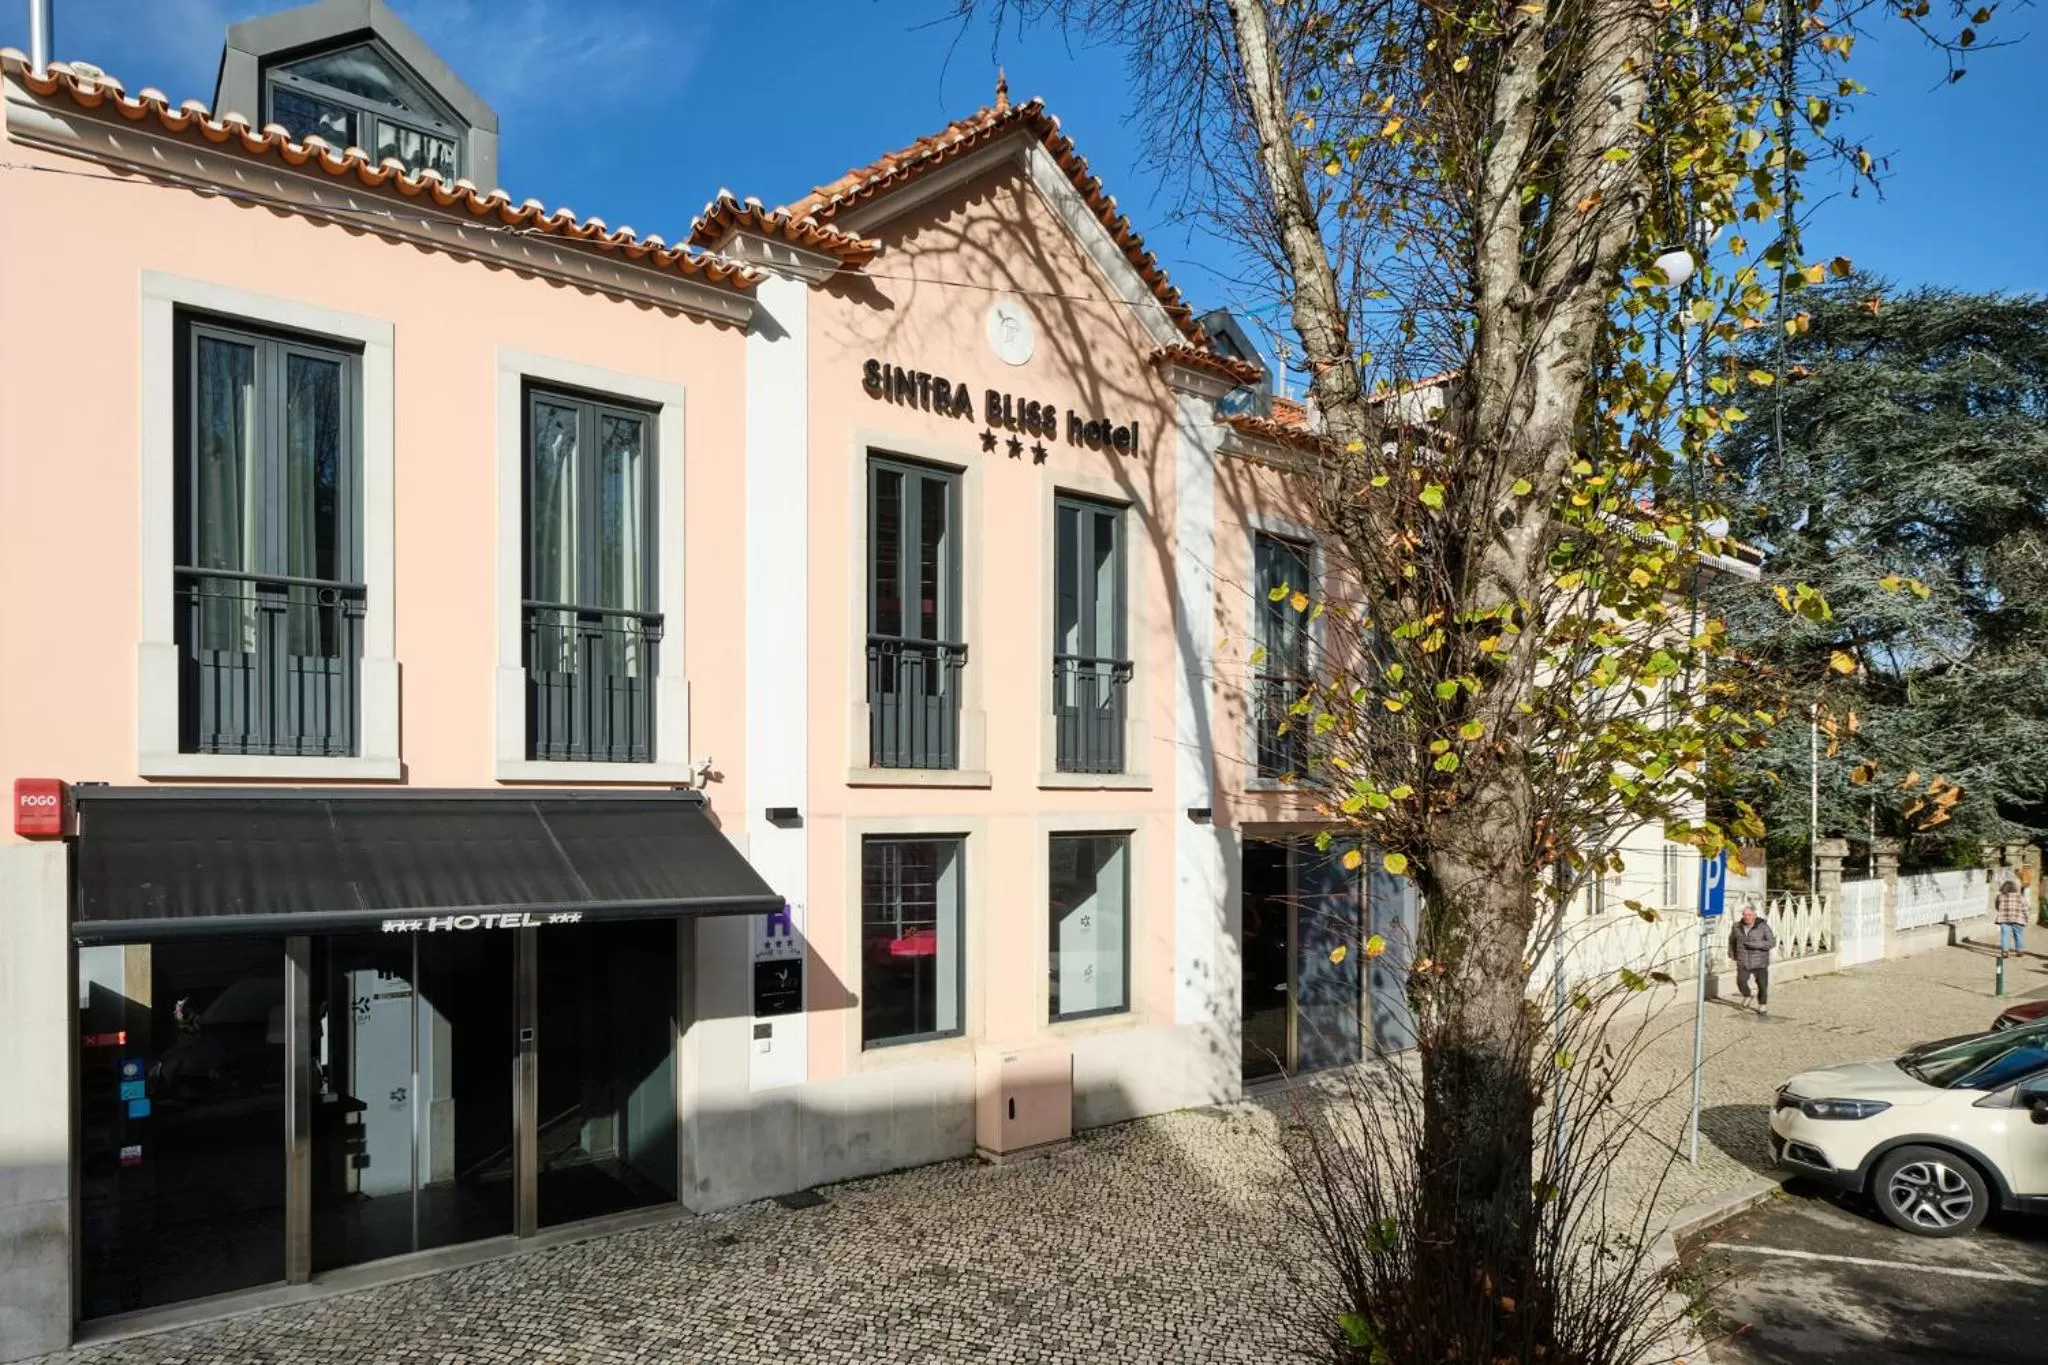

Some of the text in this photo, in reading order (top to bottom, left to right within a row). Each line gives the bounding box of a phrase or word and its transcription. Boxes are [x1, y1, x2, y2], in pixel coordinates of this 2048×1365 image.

[863, 358, 1139, 457] SINTRA BLISS hotel
[21, 795, 57, 806] FOGO
[1704, 853, 1722, 911] P
[428, 912, 541, 932] HOTEL
[767, 904, 791, 937] H
